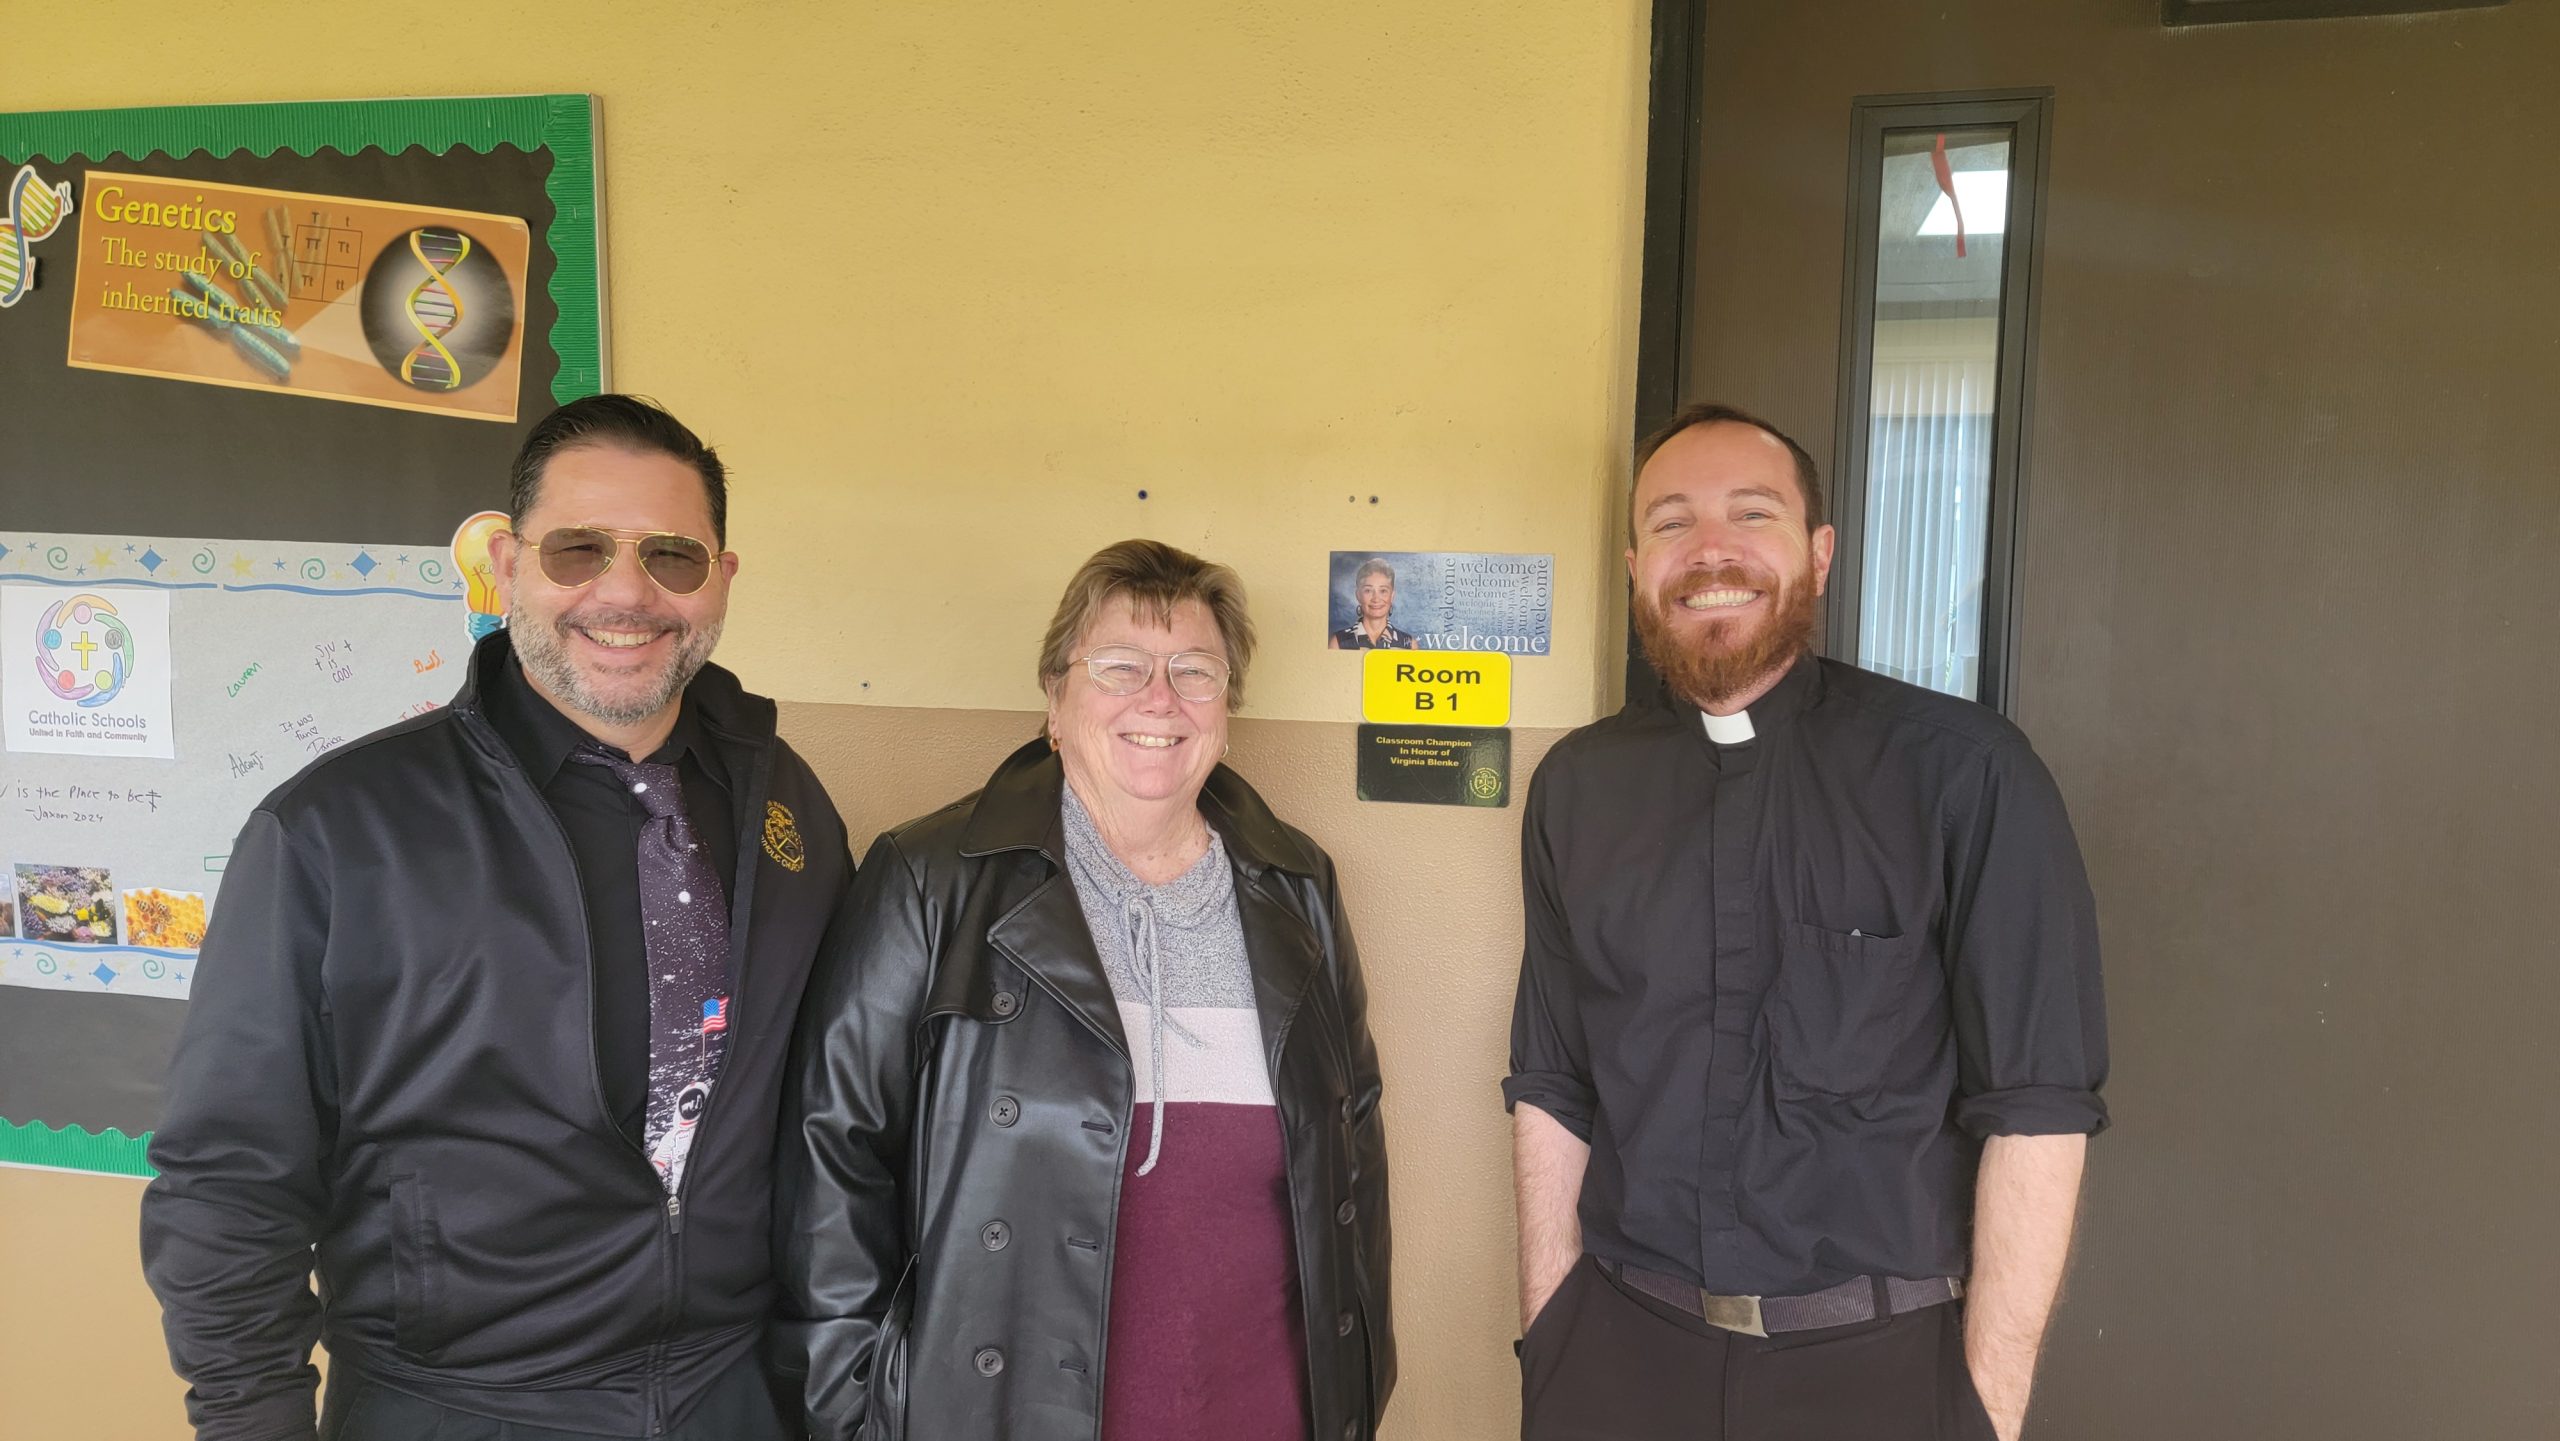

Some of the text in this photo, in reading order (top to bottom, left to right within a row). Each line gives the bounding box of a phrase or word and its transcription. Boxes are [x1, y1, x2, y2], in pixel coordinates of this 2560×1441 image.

[95, 186, 237, 235] Genetics
[312, 211, 350, 227] T t
[281, 234, 350, 254] T TT Tt
[101, 236, 262, 282] The study of
[302, 274, 314, 287] Tt
[336, 279, 345, 291] tt
[101, 281, 283, 329] inherited traits
[1461, 558, 1537, 575] welcome
[1459, 574, 1520, 588] welcome
[1439, 558, 1456, 634] welcome
[1458, 587, 1508, 599] welcome
[1530, 558, 1549, 636] welcome
[1519, 576, 1533, 635] welcome
[1424, 625, 1547, 653] welcome
[226, 661, 263, 699] Lauren
[1396, 663, 1481, 685] Room
[1415, 692, 1458, 711] B 1
[28, 710, 147, 729] Catholic Schools
[279, 713, 314, 733] It was
[29, 728, 148, 743] United in Faith and Community
[1376, 736, 1472, 748] Classroom Champion
[1400, 747, 1409, 755] In
[1411, 748, 1438, 756] Honor
[1390, 756, 1460, 767] Virginia Blenke
[17, 779, 29, 799] is
[36, 786, 60, 799] the
[73, 812, 104, 823] 2024
